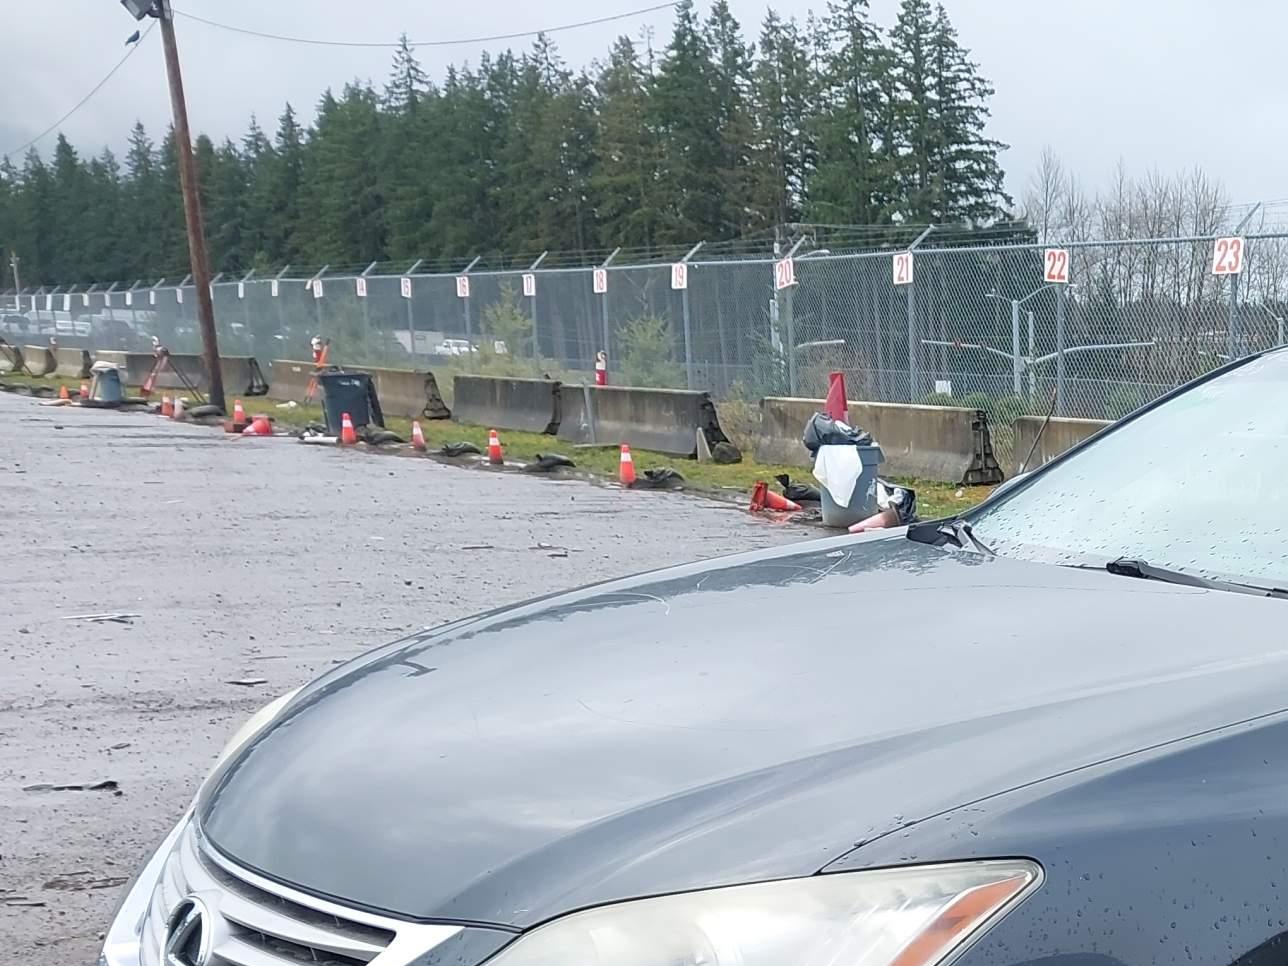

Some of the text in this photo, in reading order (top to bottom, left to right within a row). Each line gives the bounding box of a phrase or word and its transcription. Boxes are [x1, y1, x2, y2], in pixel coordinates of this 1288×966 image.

[897, 255, 909, 282] 21
[1047, 251, 1066, 280] 22
[1215, 239, 1241, 272] 23
[525, 275, 533, 294] 17
[595, 271, 605, 292] 18
[674, 264, 684, 287] 19
[777, 260, 792, 288] 20
